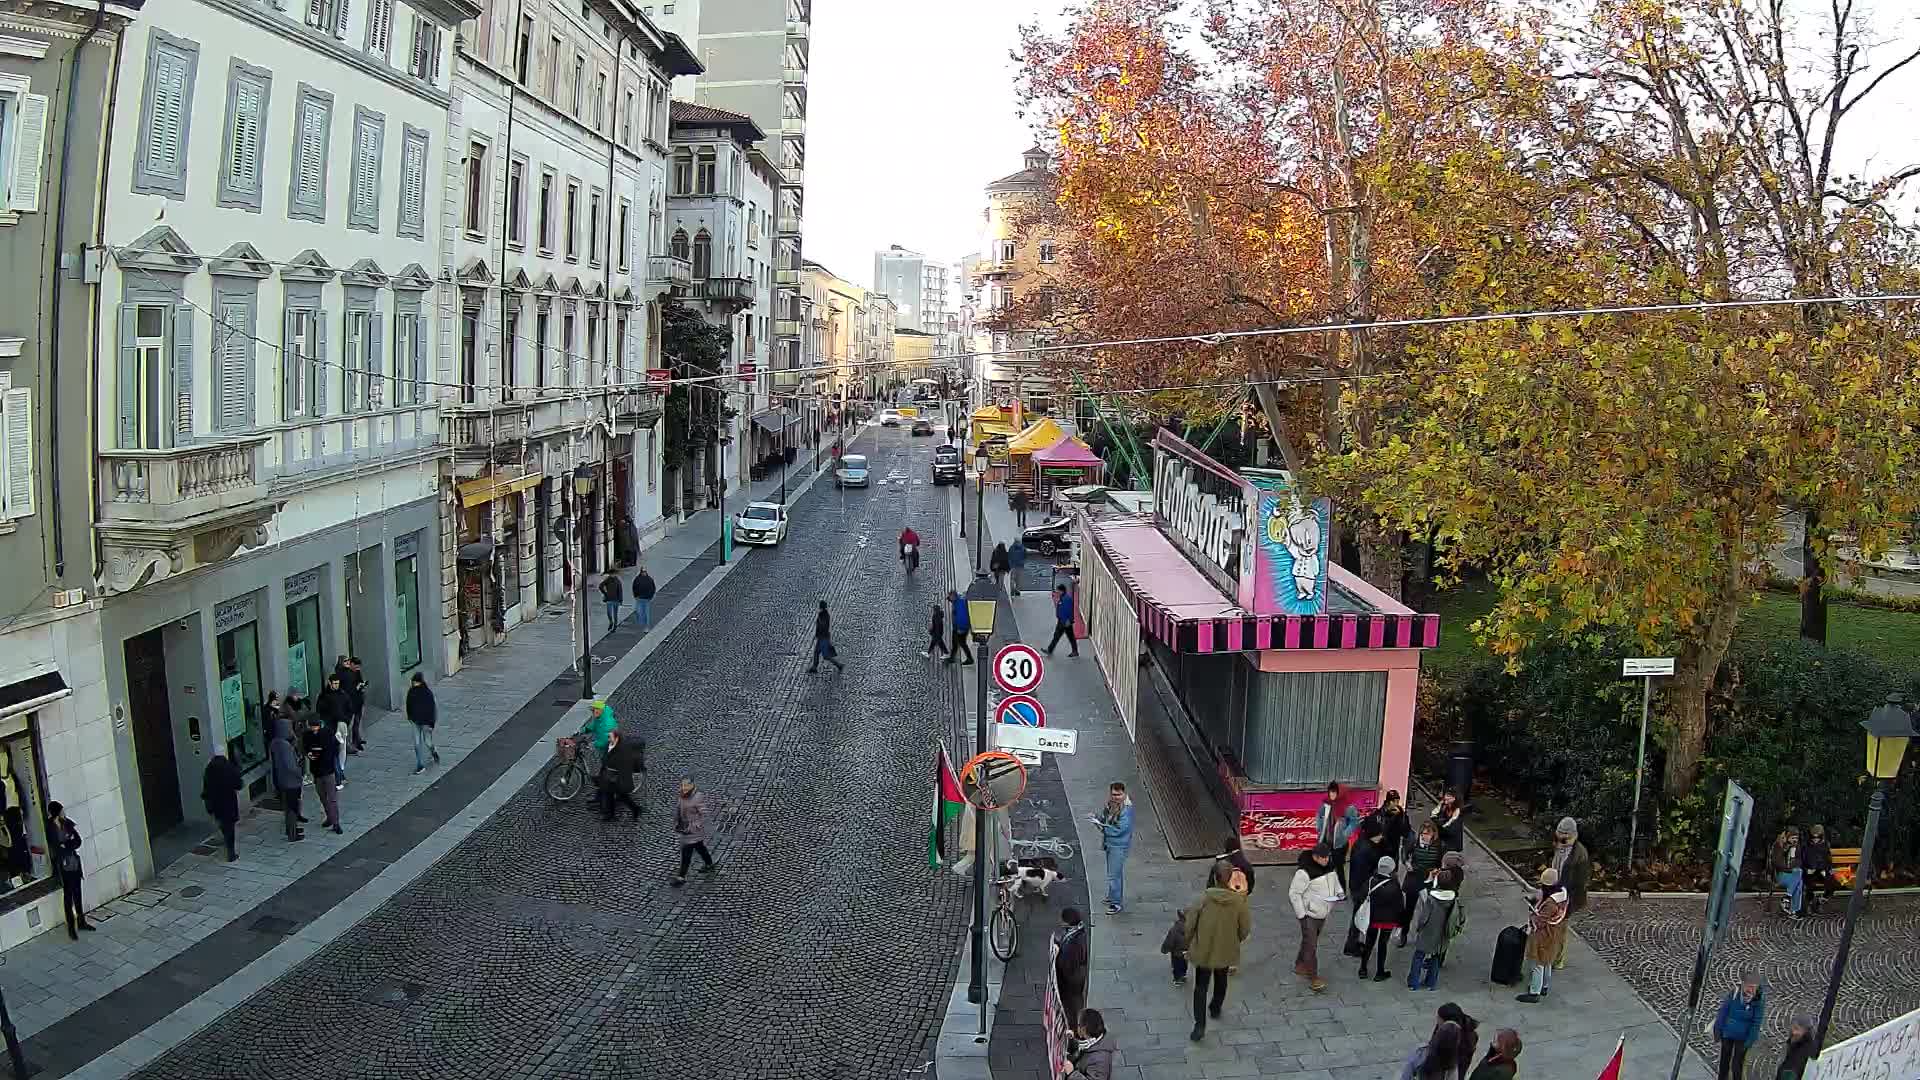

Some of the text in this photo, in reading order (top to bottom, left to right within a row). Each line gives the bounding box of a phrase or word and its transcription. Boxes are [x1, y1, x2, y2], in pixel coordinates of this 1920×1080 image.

[1163, 459, 1232, 569] Golosone
[1005, 658, 1032, 679] 30
[1038, 737, 1070, 748] Dante
